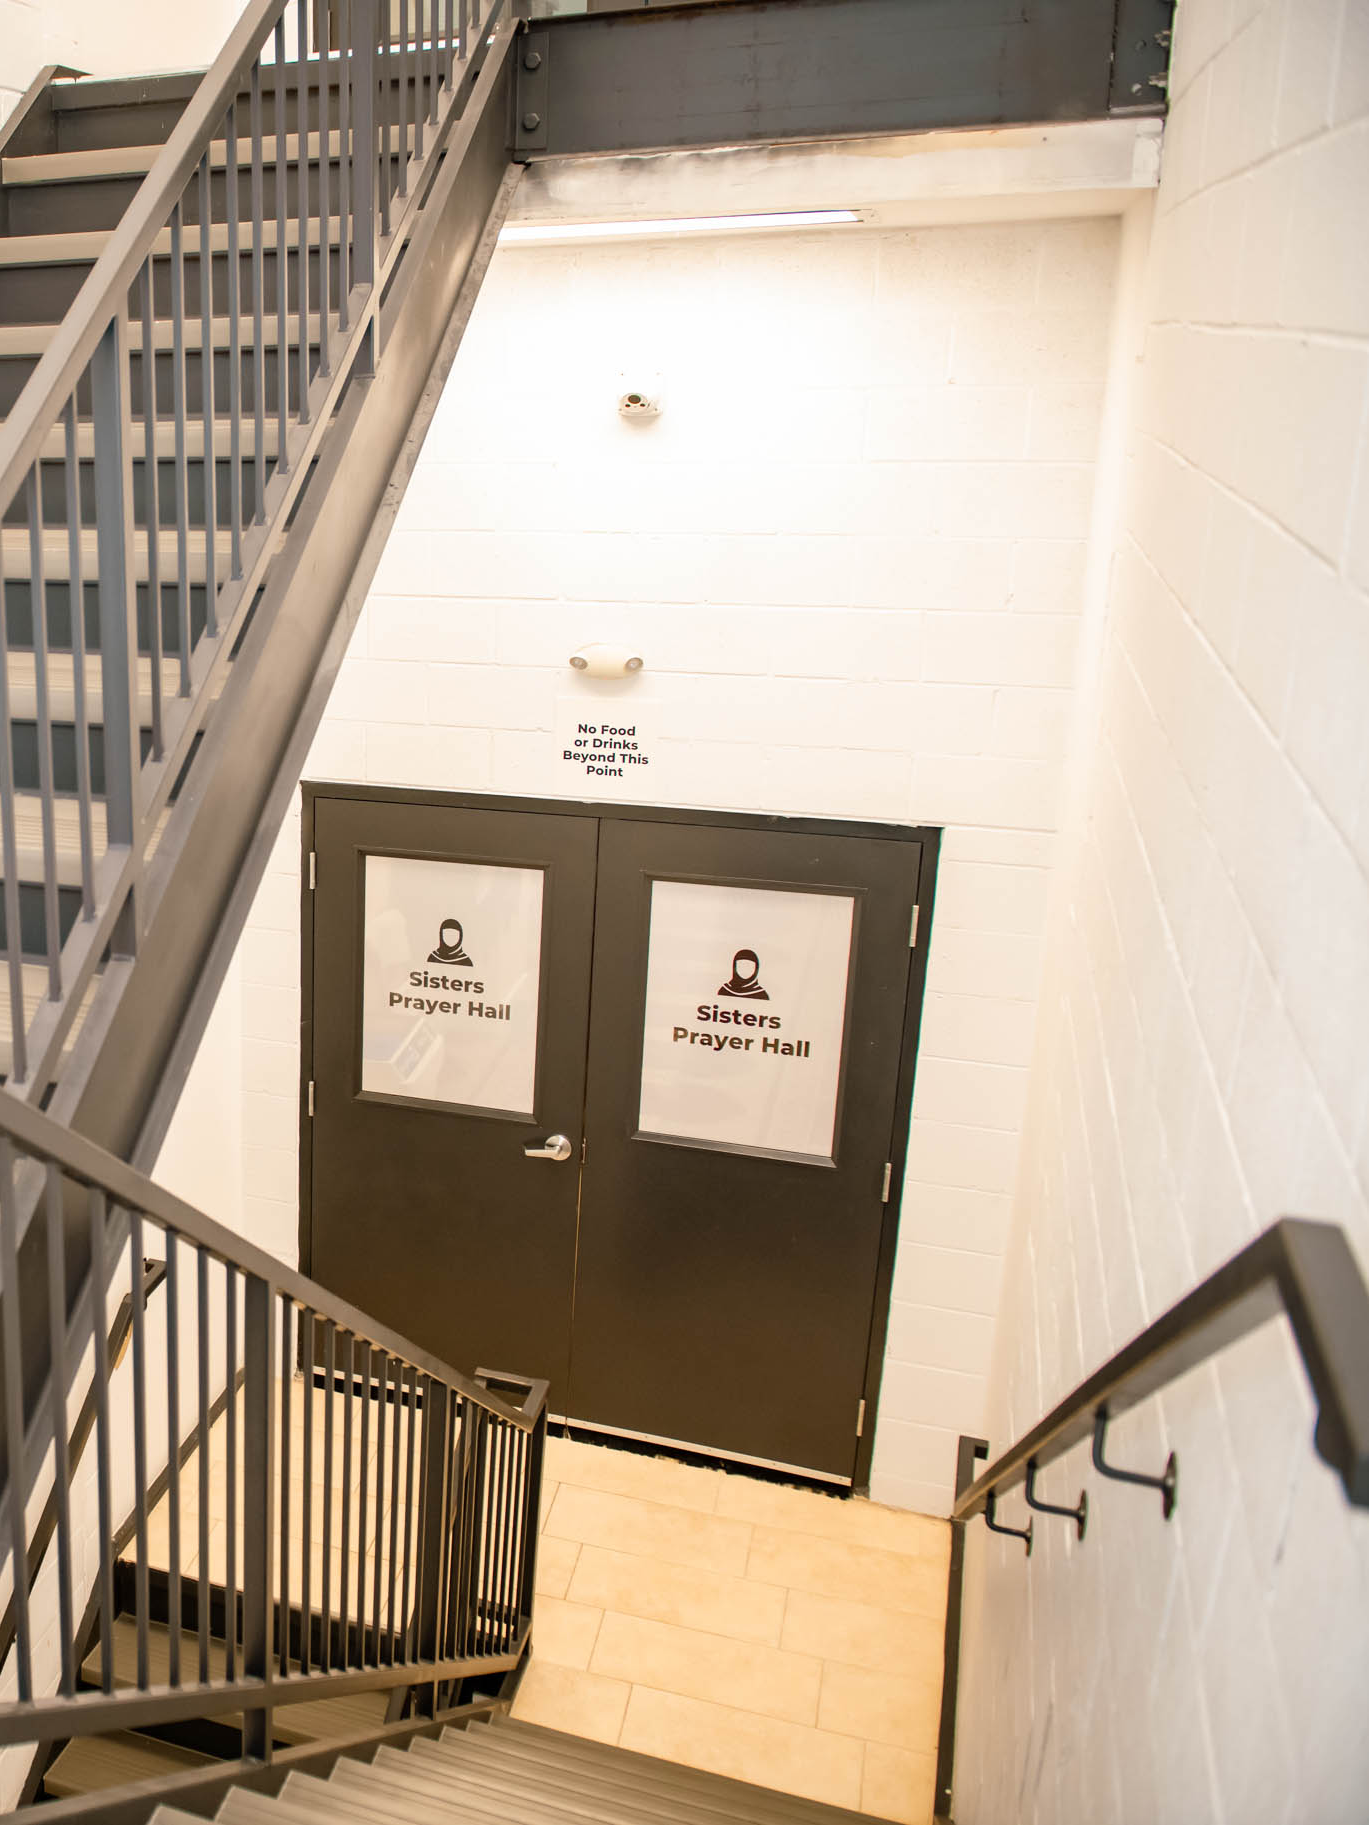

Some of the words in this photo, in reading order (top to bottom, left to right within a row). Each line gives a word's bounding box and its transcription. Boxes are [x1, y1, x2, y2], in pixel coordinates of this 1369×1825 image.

[578, 723, 597, 734] No
[601, 725, 636, 736] Food
[574, 739, 588, 747] or
[593, 738, 638, 750] Drinks
[563, 750, 615, 763] Beyond
[620, 753, 649, 765] This
[586, 765, 623, 777] Point
[408, 971, 485, 994] Sisters
[388, 991, 463, 1015] Prayer
[468, 1001, 512, 1021] Hall
[696, 1004, 782, 1029] Sisters
[672, 1026, 754, 1052] Prayer
[761, 1036, 811, 1058] Hall
